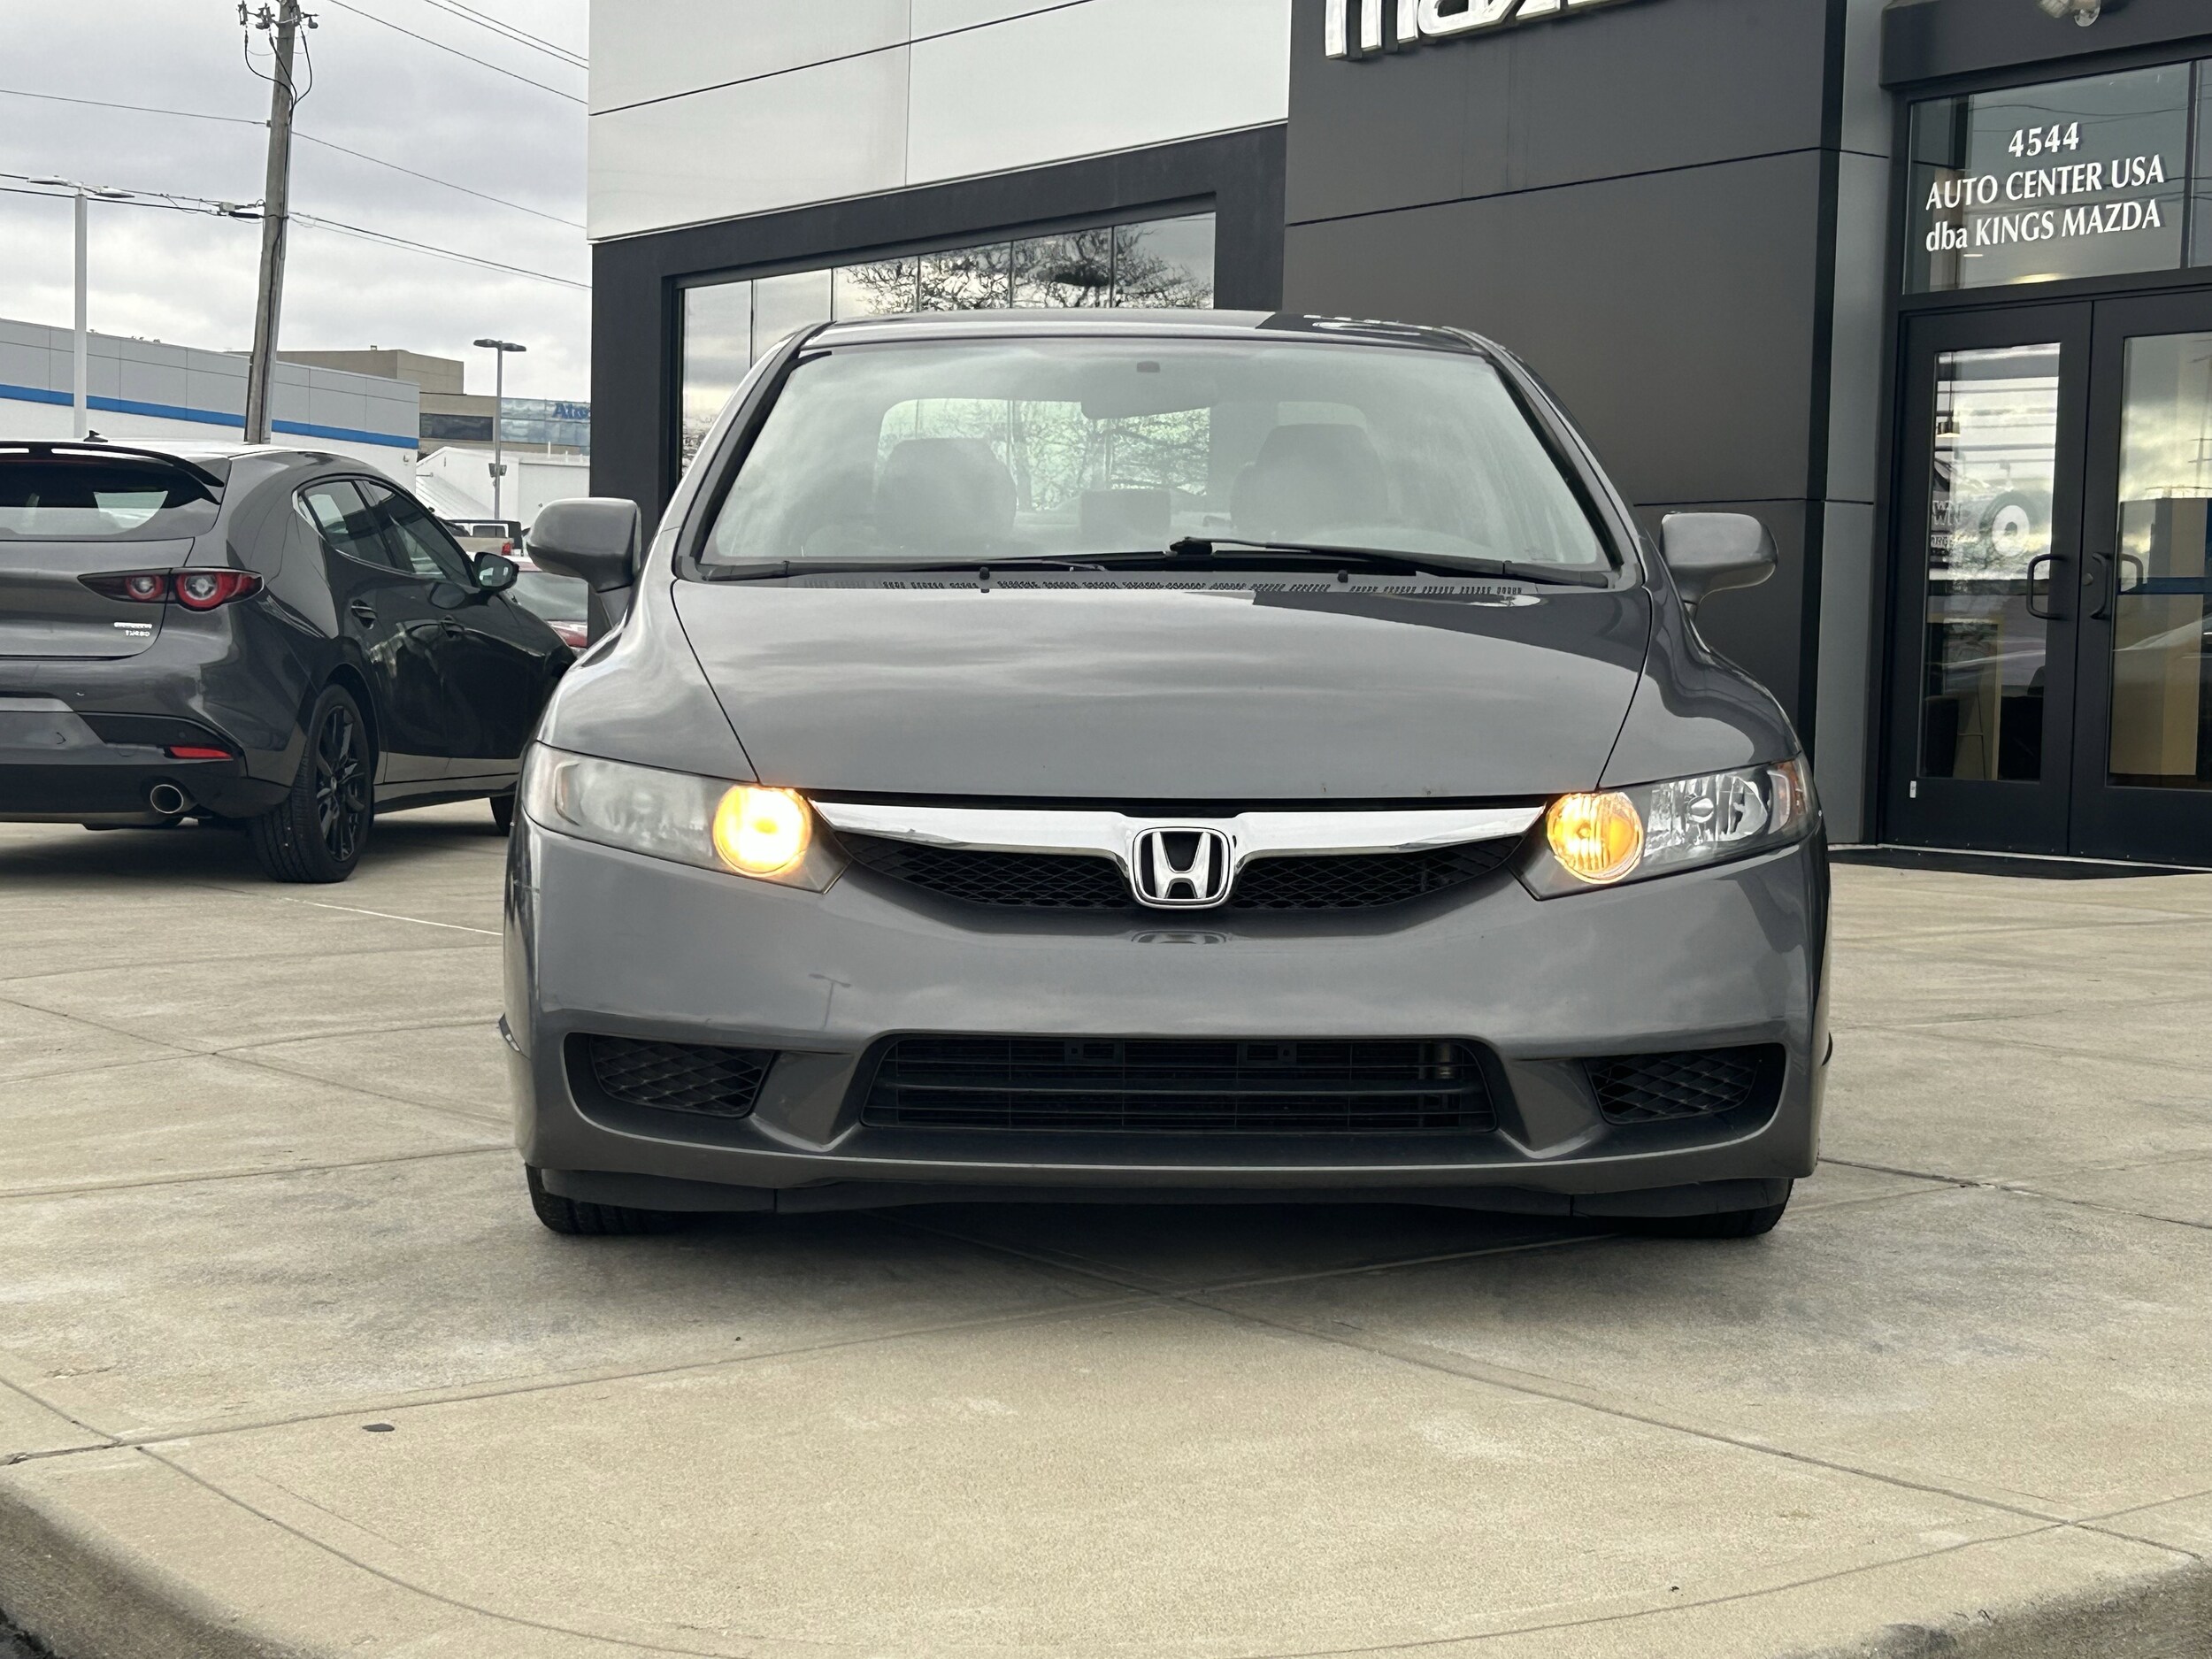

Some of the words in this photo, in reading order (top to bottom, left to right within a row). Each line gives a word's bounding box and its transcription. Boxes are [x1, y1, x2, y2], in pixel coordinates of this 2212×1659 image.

[2008, 122, 2079, 157] 4544
[1925, 175, 1998, 211] AUTO
[2005, 162, 2102, 201] CENTER
[2111, 154, 2164, 188] USA
[1925, 221, 1968, 251] dba
[1975, 210, 2054, 246] KINGS
[2061, 199, 2161, 237] MAZDA
